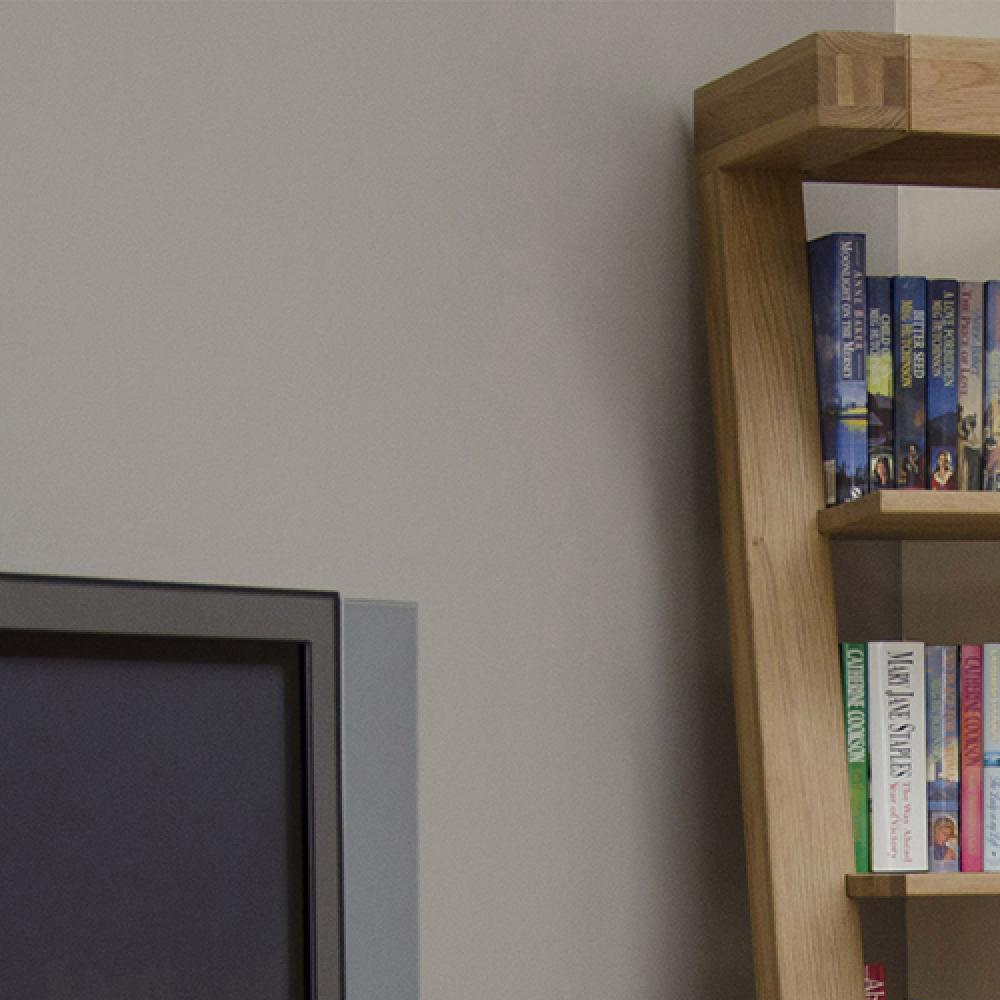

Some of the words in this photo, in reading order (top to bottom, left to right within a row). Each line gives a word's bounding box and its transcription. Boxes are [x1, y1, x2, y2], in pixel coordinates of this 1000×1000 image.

[913, 310, 924, 349] BITTER
[913, 352, 924, 379] SEED
[847, 648, 865, 708] CATHERINE
[886, 650, 914, 689] MARY
[884, 690, 914, 722] JANE
[847, 711, 865, 764] COOKSON
[888, 724, 916, 779] STAPLES
